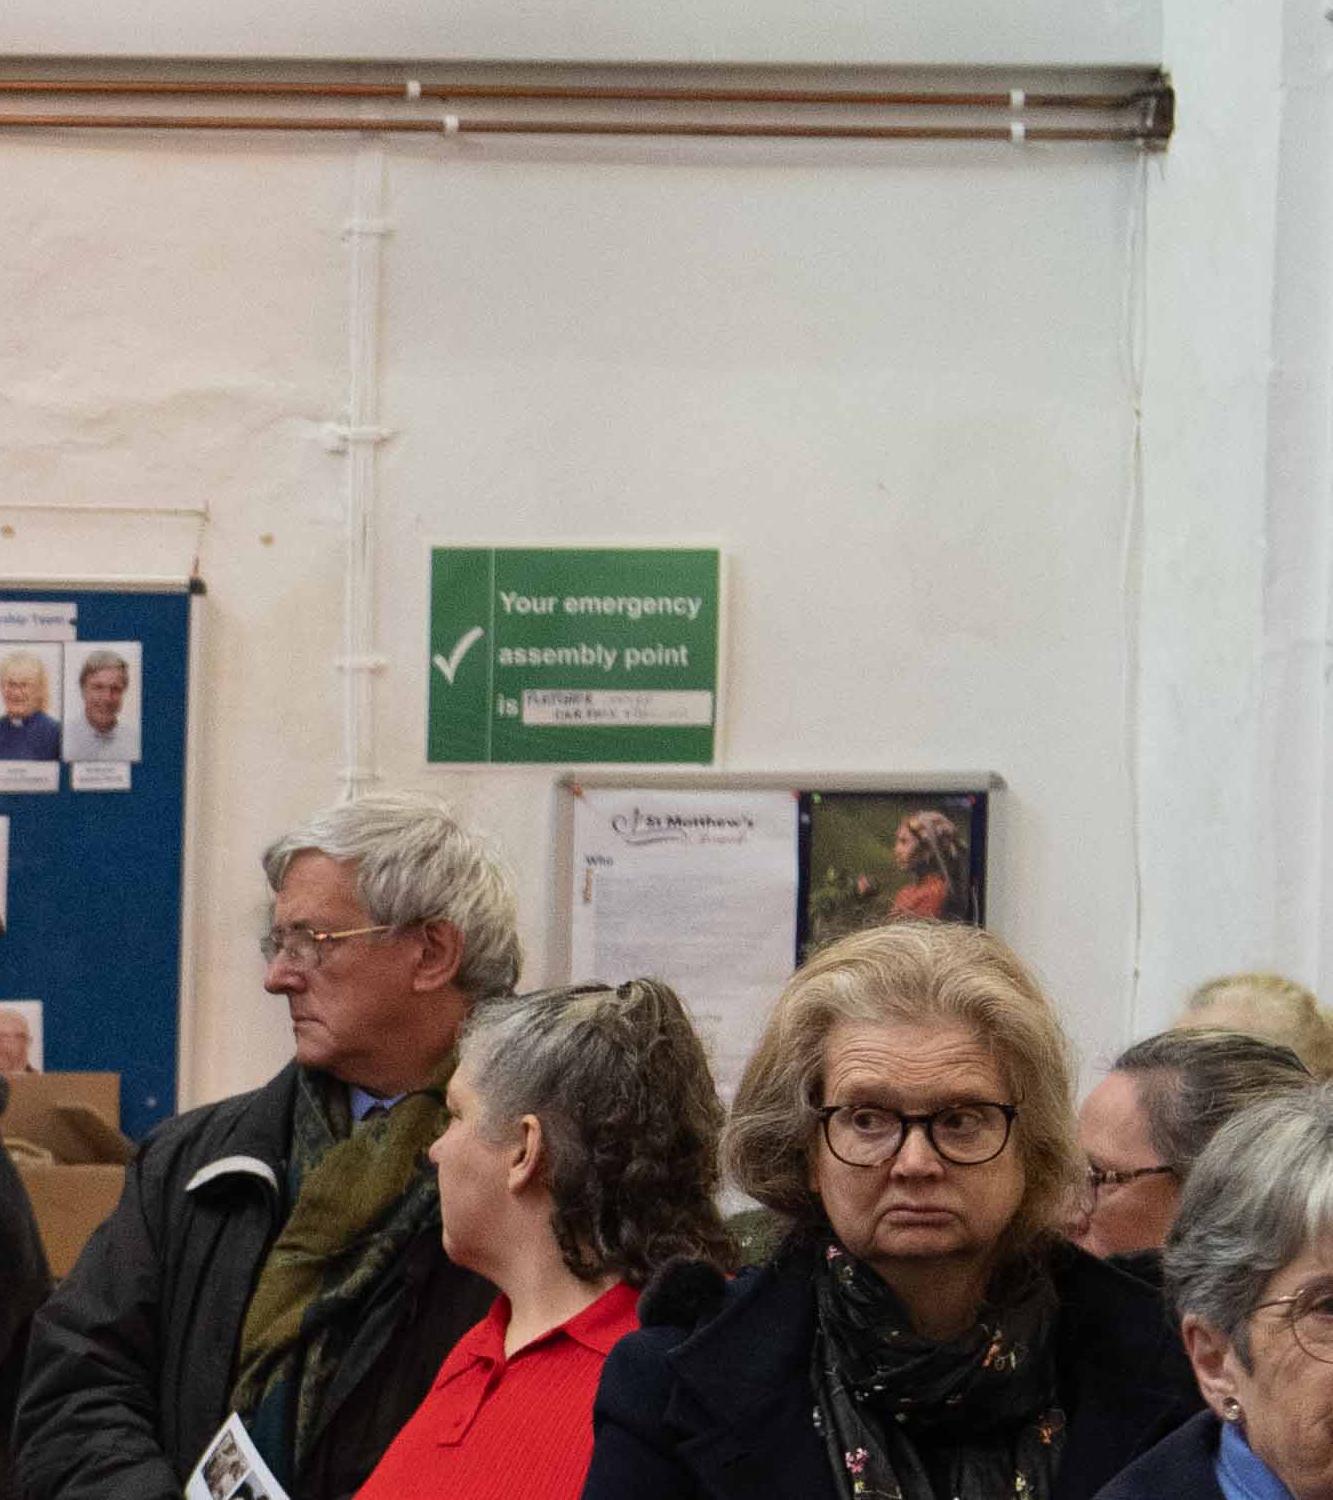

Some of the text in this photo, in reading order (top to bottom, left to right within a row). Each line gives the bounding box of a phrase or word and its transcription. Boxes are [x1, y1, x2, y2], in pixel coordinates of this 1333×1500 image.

[499, 591, 702, 620] Your emergency
[499, 644, 689, 671] assembly point
[585, 855, 614, 867] Who
